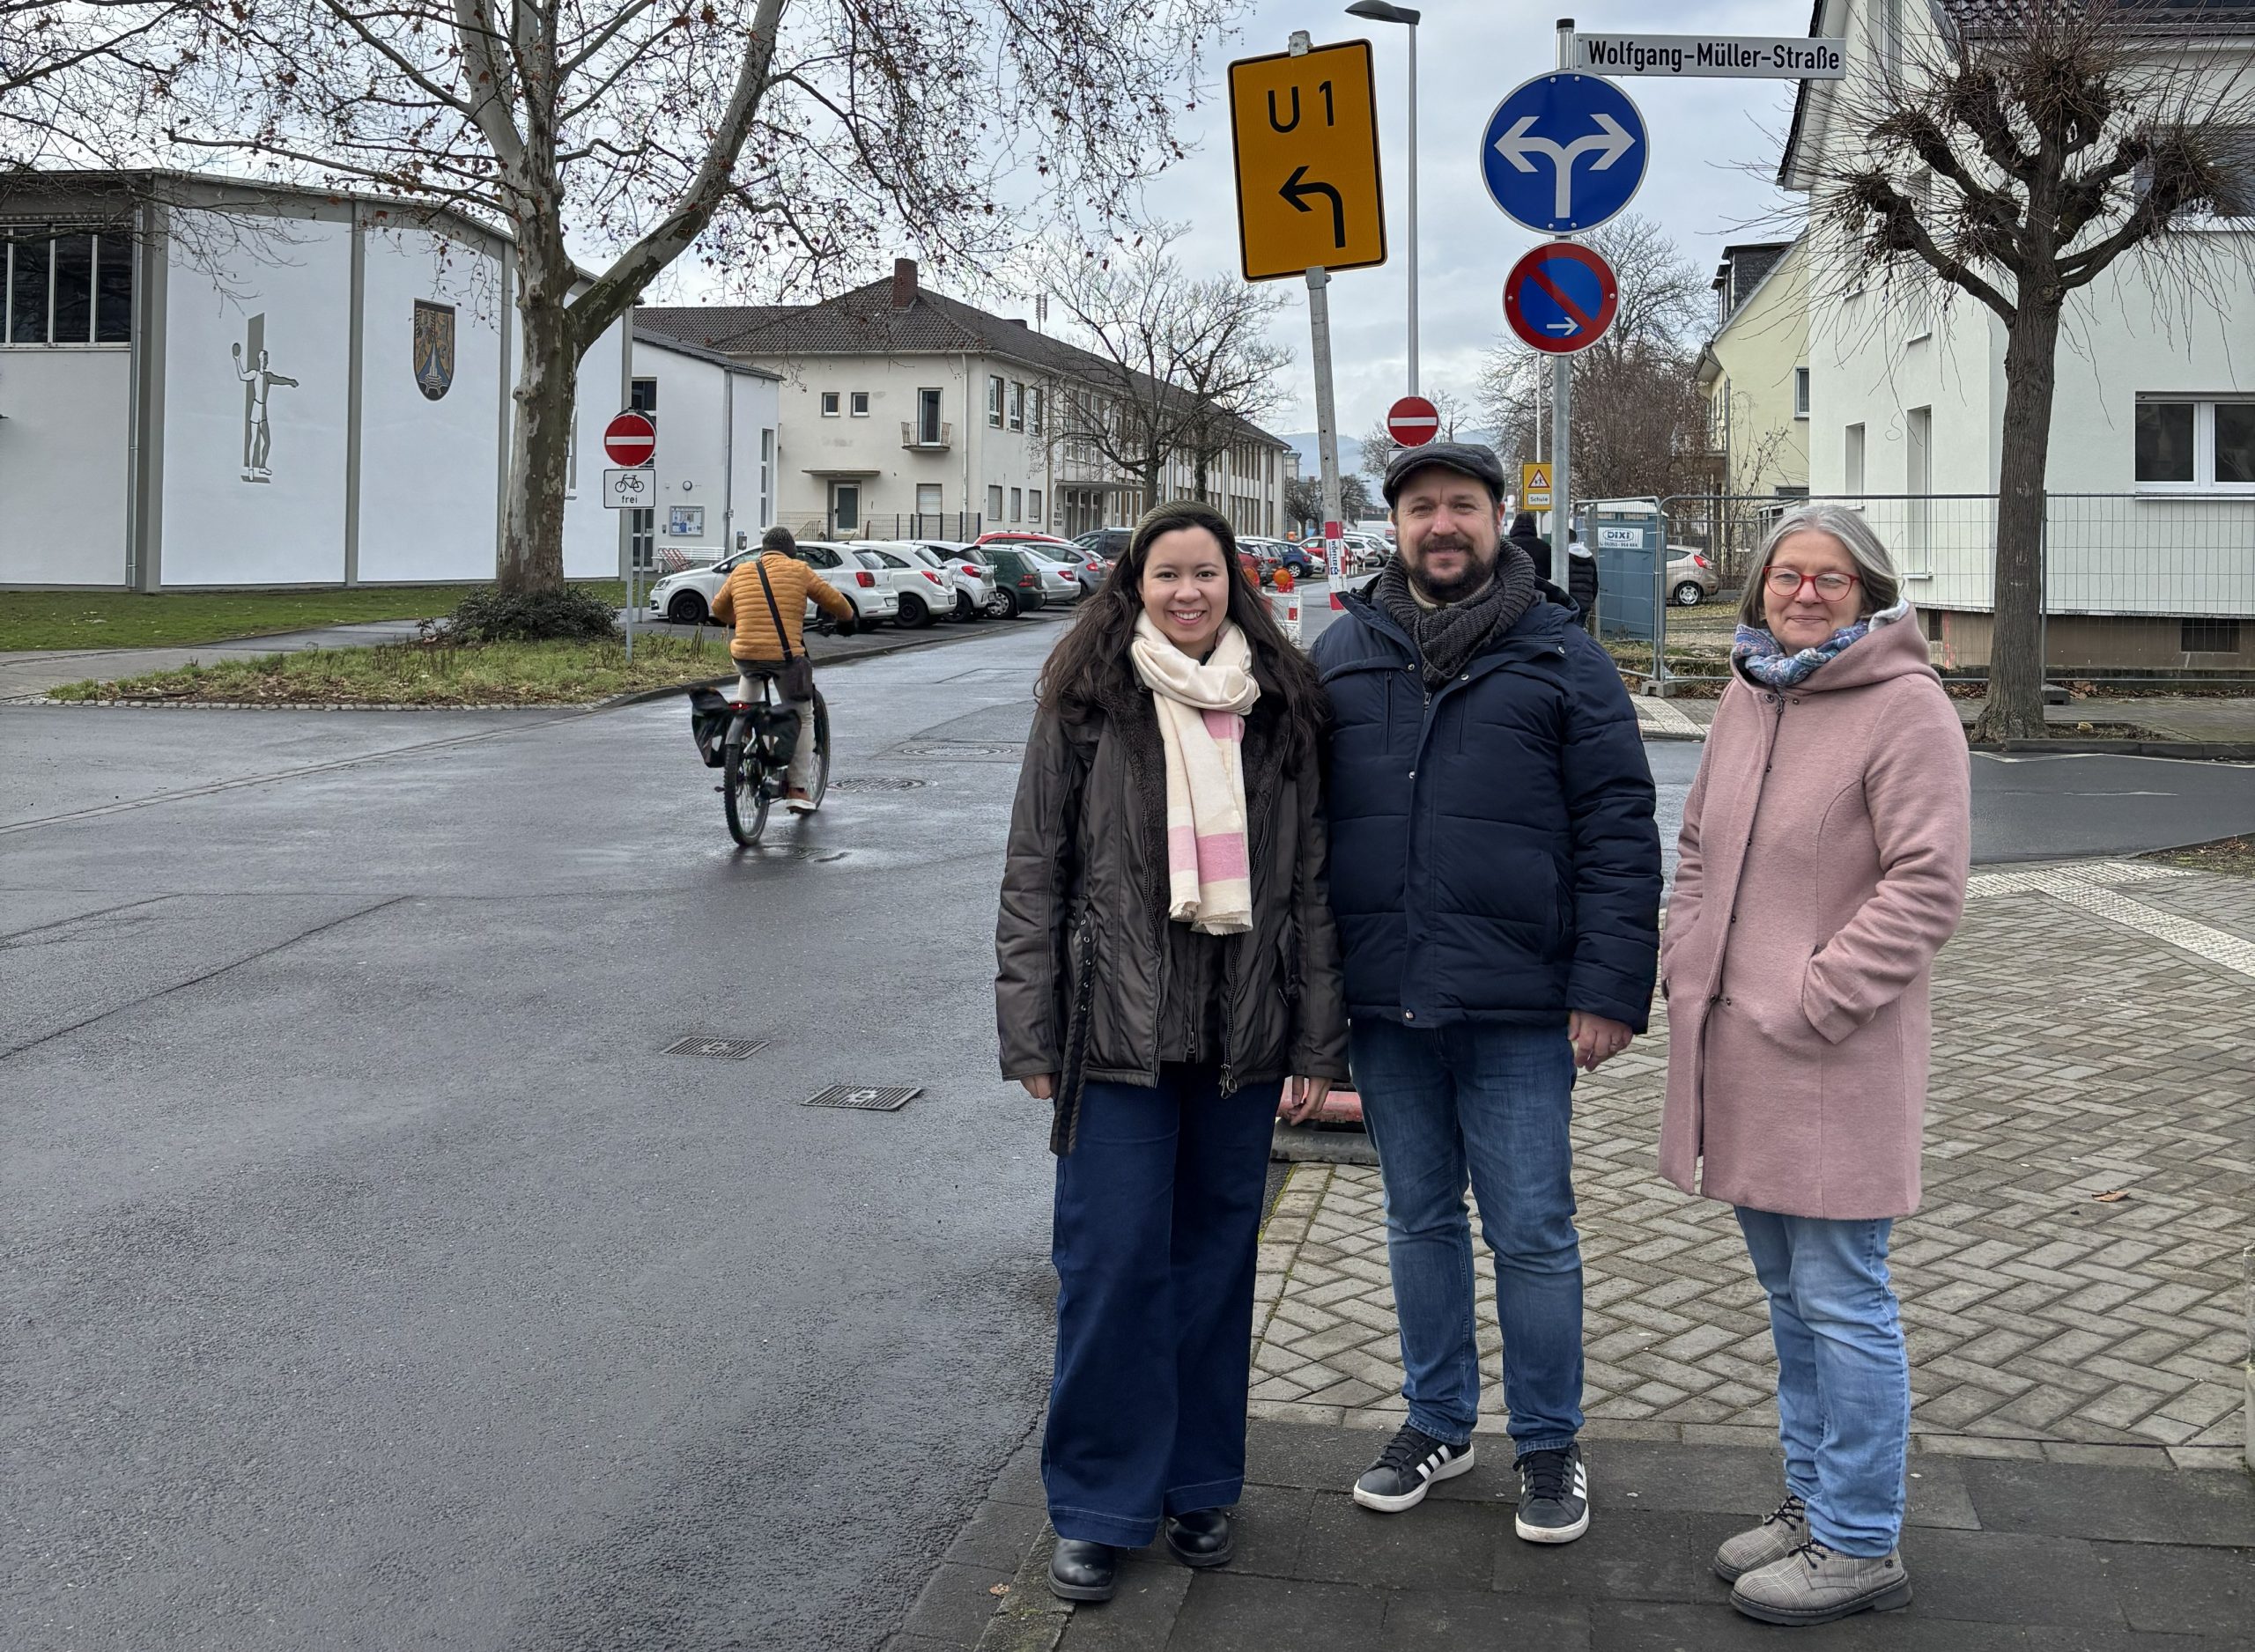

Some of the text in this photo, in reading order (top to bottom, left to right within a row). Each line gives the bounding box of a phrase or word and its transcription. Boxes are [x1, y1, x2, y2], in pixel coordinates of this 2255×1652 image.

[1587, 40, 1839, 72] Wolfgang-Müller-Straße
[1268, 80, 1335, 133] U 1
[621, 495, 638, 504] frei
